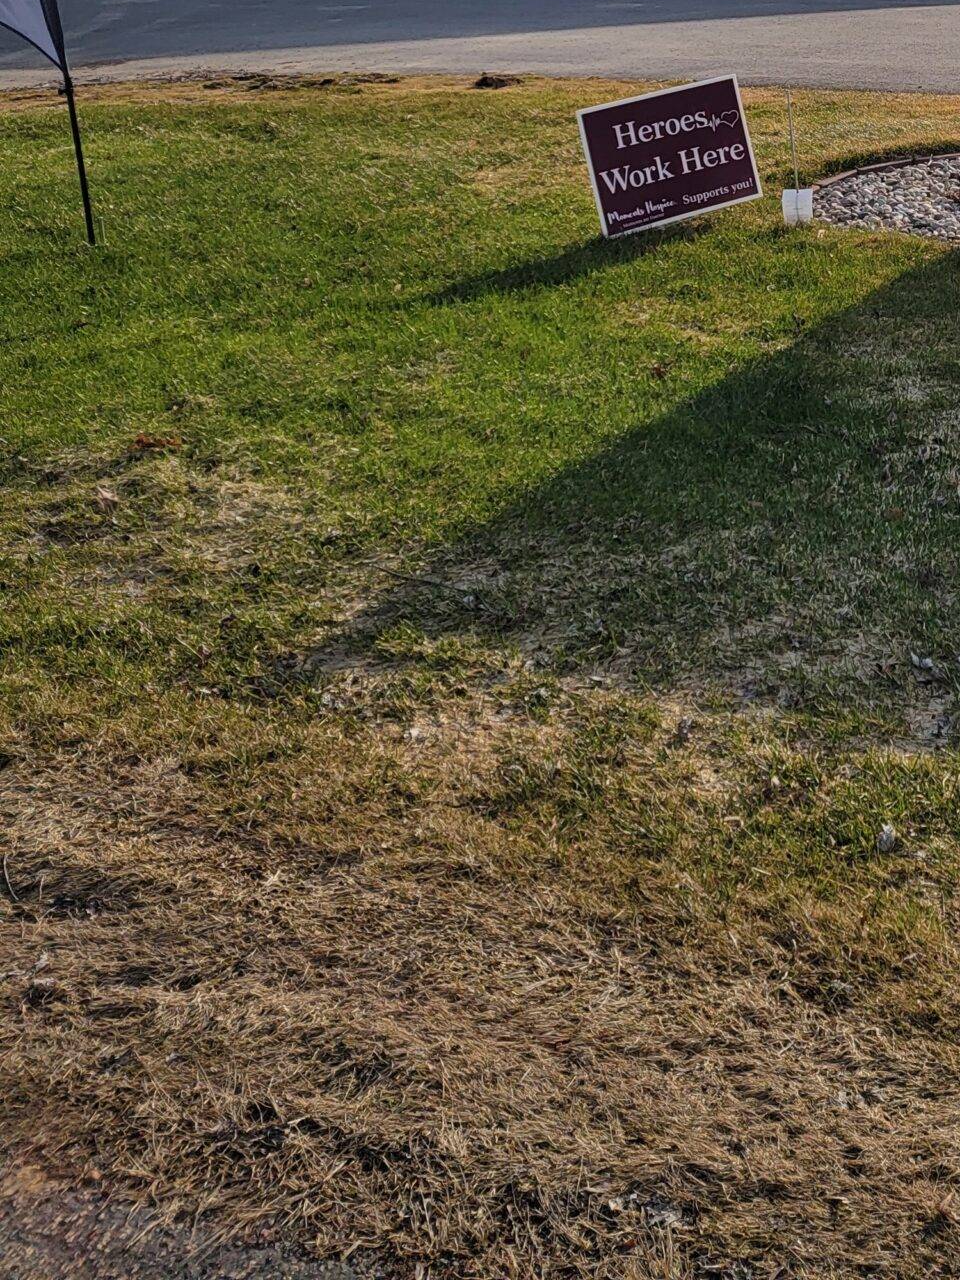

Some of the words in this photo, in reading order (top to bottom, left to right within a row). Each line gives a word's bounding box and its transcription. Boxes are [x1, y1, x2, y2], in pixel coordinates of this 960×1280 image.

[612, 110, 707, 150] Heroes
[599, 156, 675, 194] Work
[678, 143, 745, 175] Here
[607, 207, 645, 225] Moments
[645, 198, 674, 215] Hospice
[682, 185, 730, 205] Supports
[731, 177, 753, 195] you!
